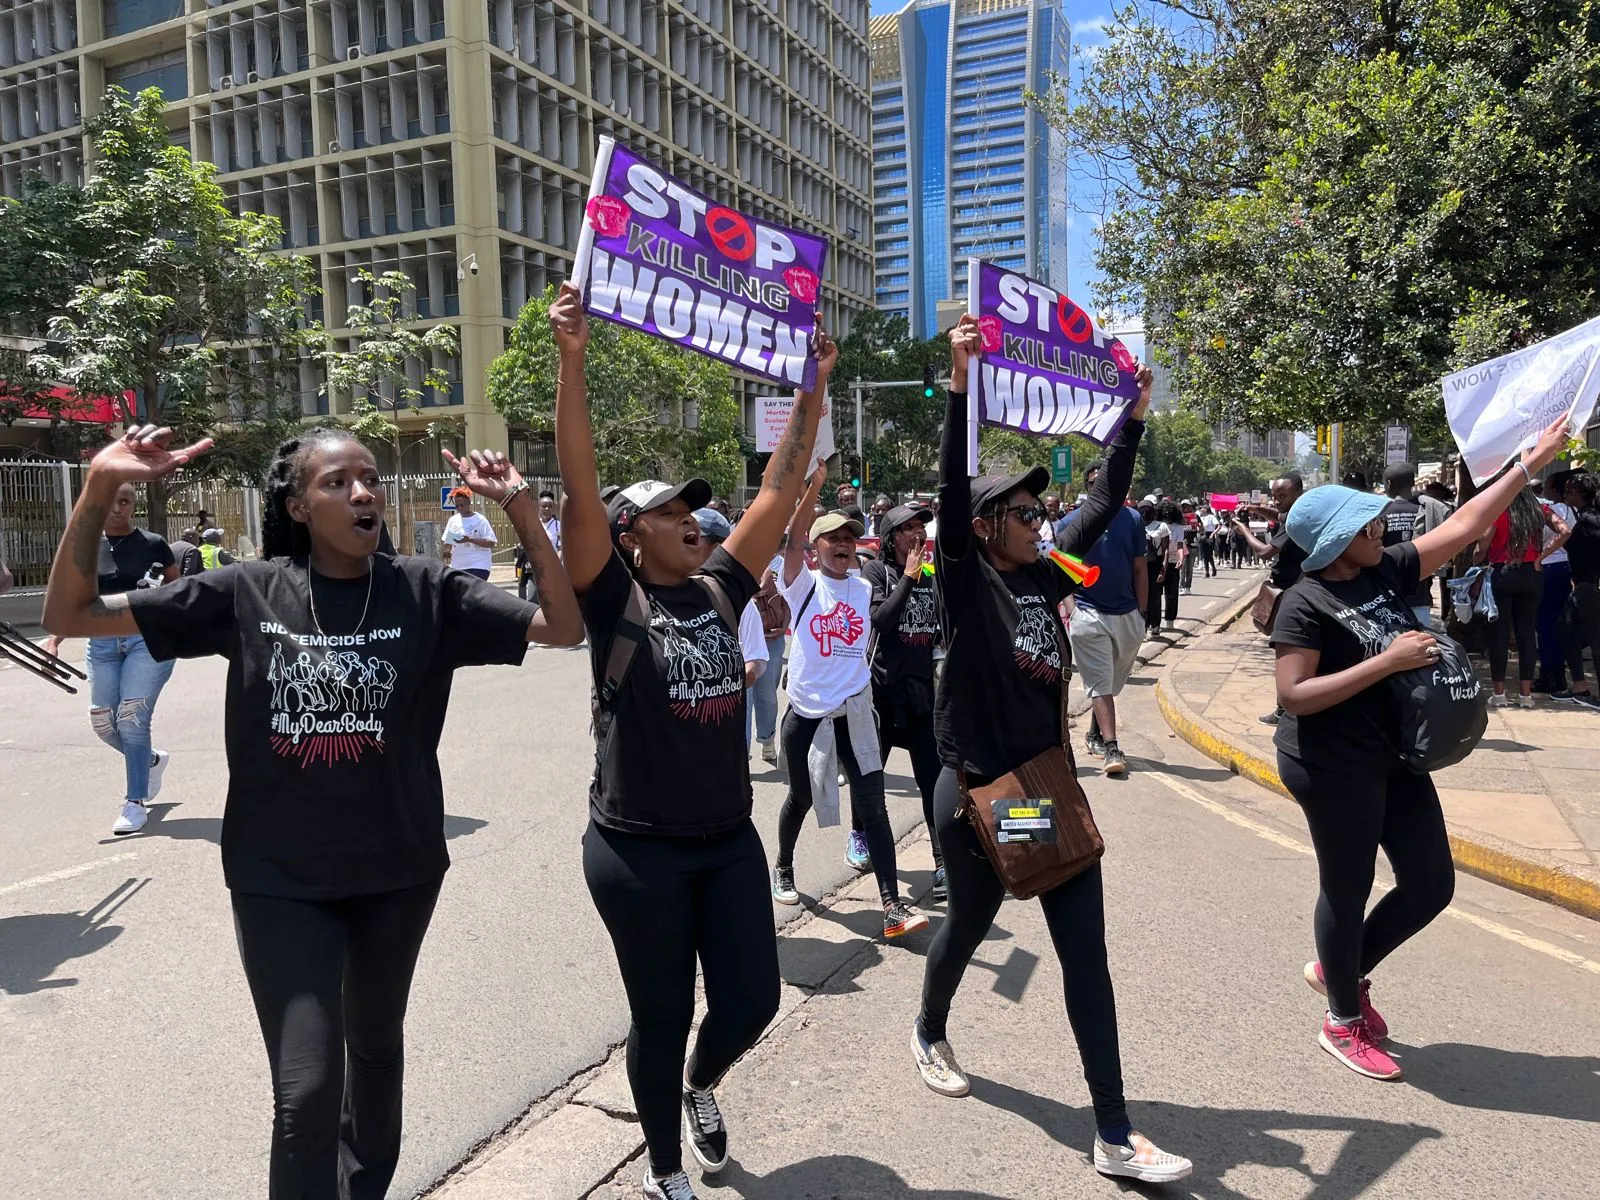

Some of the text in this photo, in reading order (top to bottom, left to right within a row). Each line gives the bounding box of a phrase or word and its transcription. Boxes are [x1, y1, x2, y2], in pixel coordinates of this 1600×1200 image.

[623, 164, 796, 270] STOP
[626, 222, 790, 313] KILLING
[589, 247, 808, 385] WOMEN
[1003, 331, 1120, 389] KILLING
[270, 712, 384, 744] #MyDearBody
[669, 675, 743, 708] #MyDearBod
